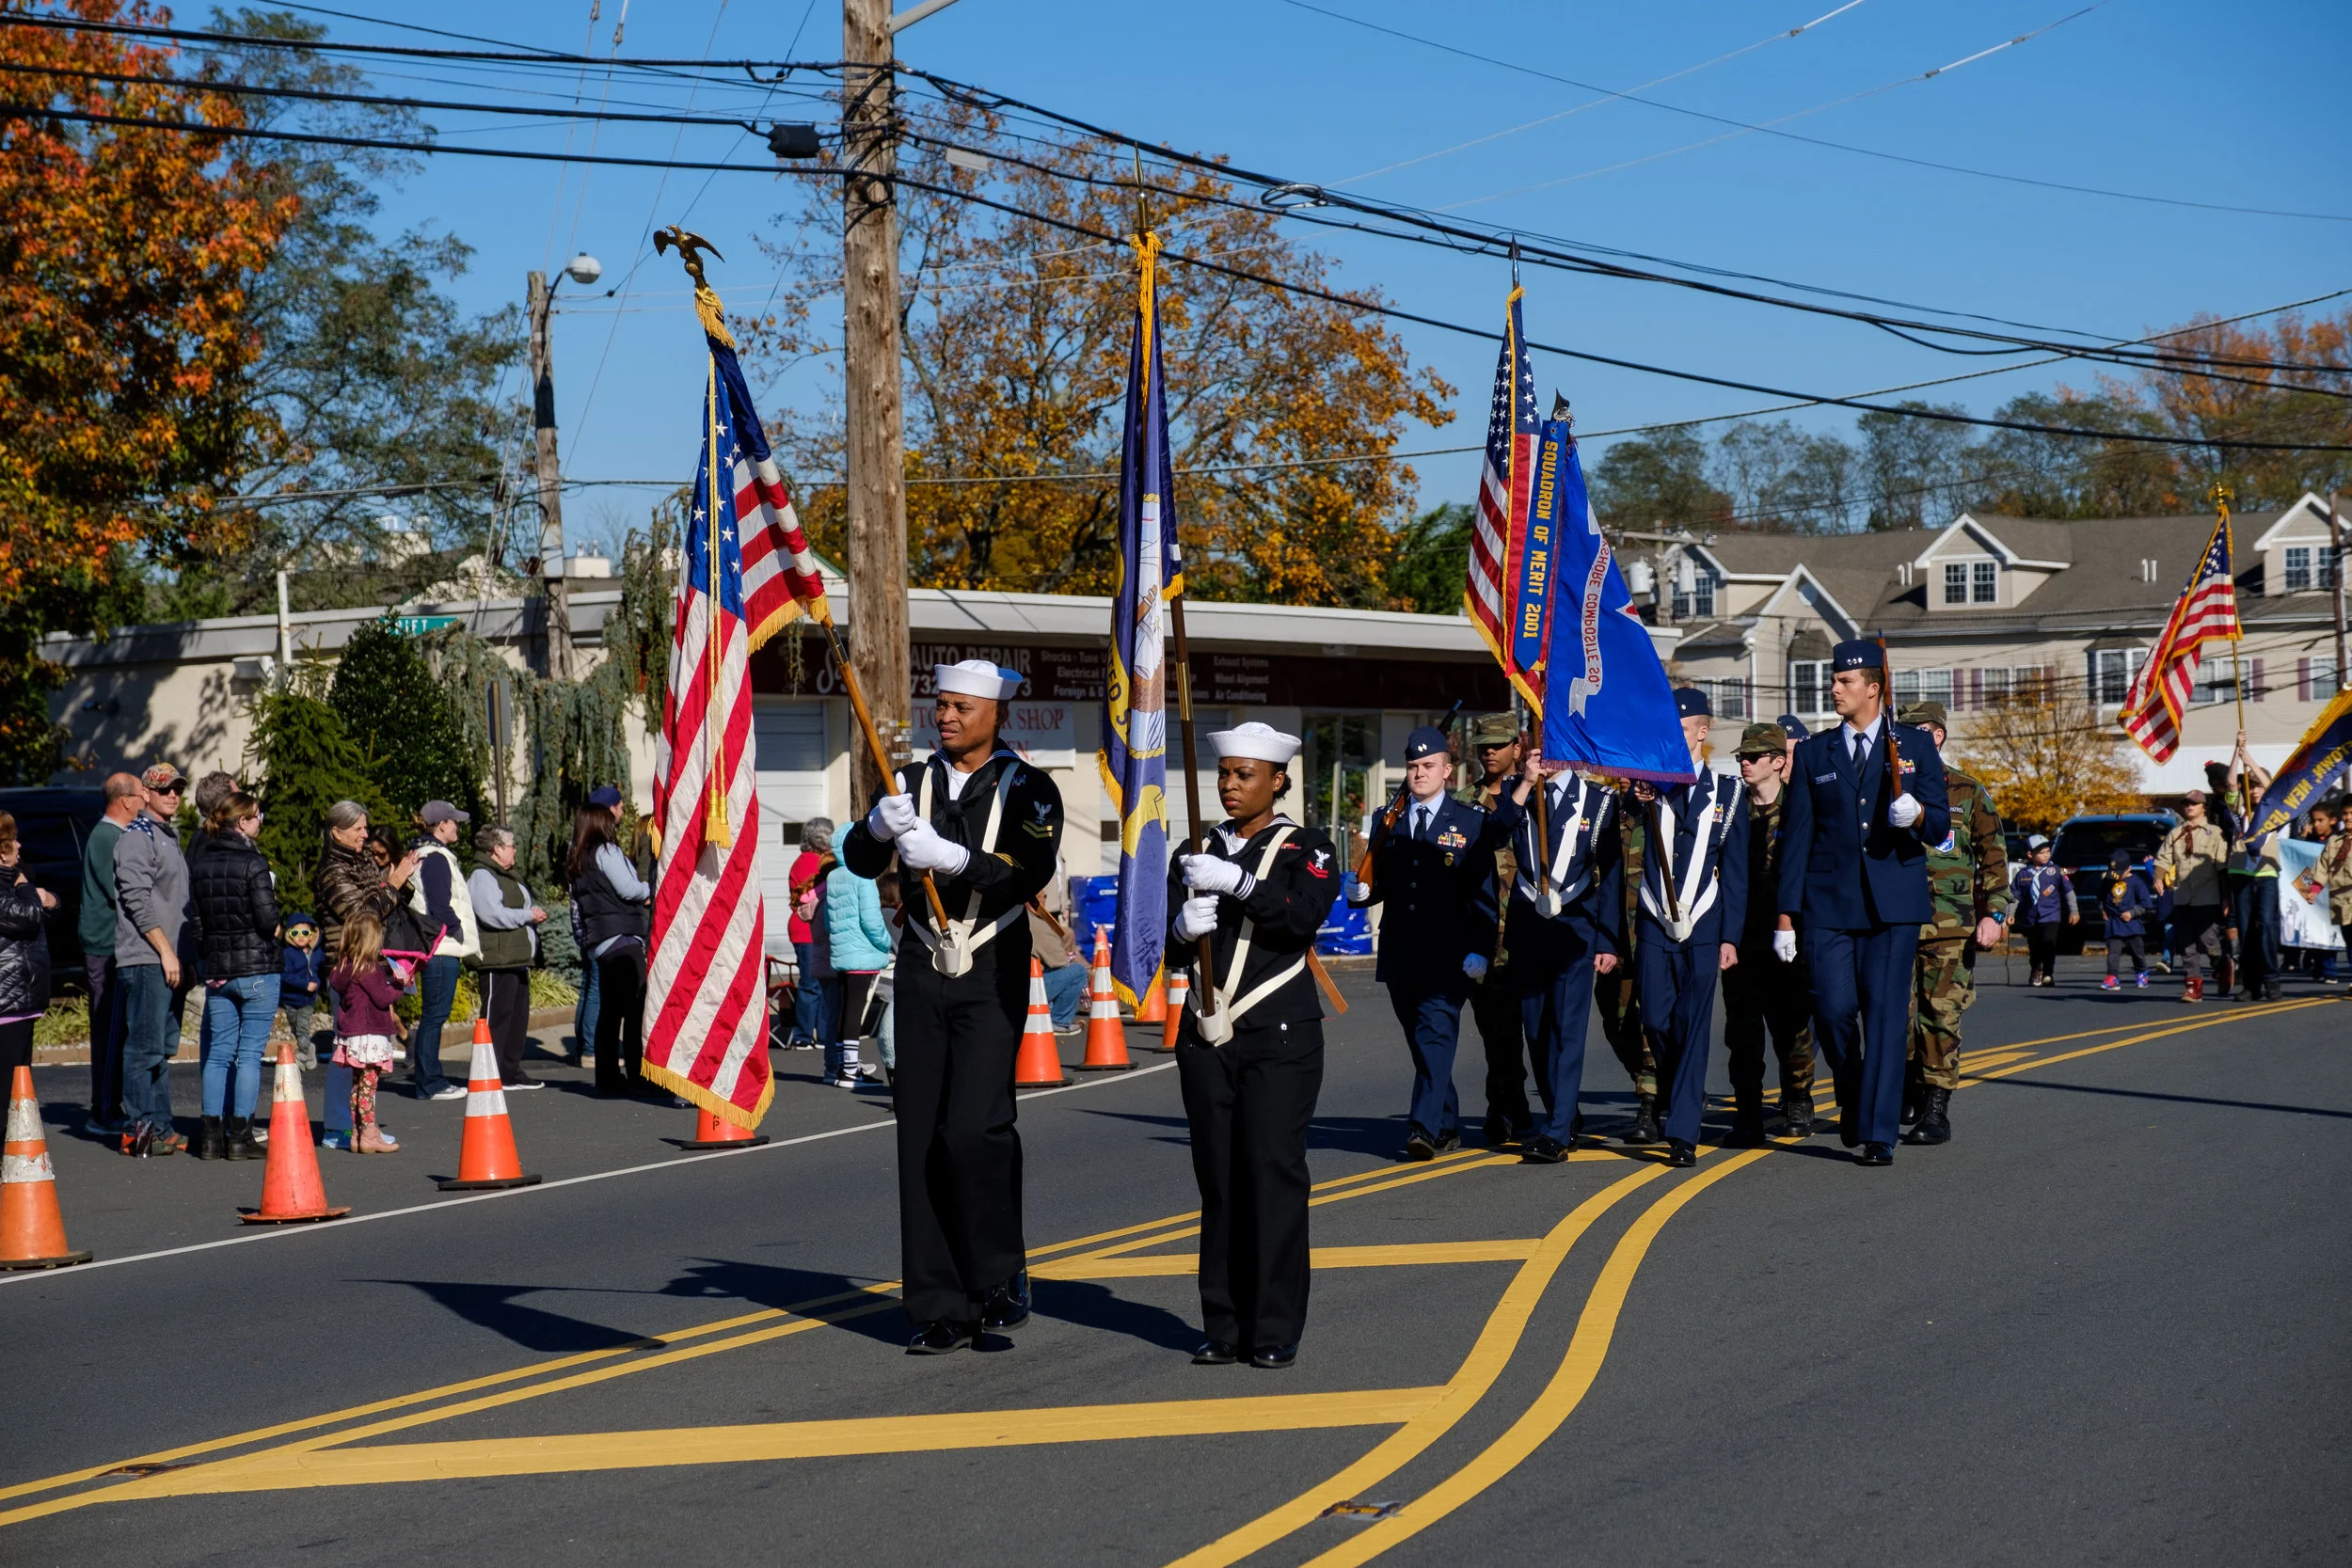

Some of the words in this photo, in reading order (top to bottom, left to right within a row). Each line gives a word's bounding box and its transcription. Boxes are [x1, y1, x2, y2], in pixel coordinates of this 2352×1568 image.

[1536, 441, 1559, 519] SQUADRON
[1533, 526, 1549, 545] OF
[1528, 550, 1548, 595] MERIT
[1522, 603, 1541, 639] 2001
[910, 644, 961, 672] AUTO
[1214, 656, 1240, 667] Exhaust
[1242, 657, 1269, 670] Systems
[1057, 666, 1099, 678] Electrical
[1237, 673, 1270, 687] Alignment
[1054, 685, 1087, 699] Foreign
[1215, 689, 1226, 701] Air
[1226, 689, 1267, 703] Conditioning
[1016, 707, 1064, 730] SHOP
